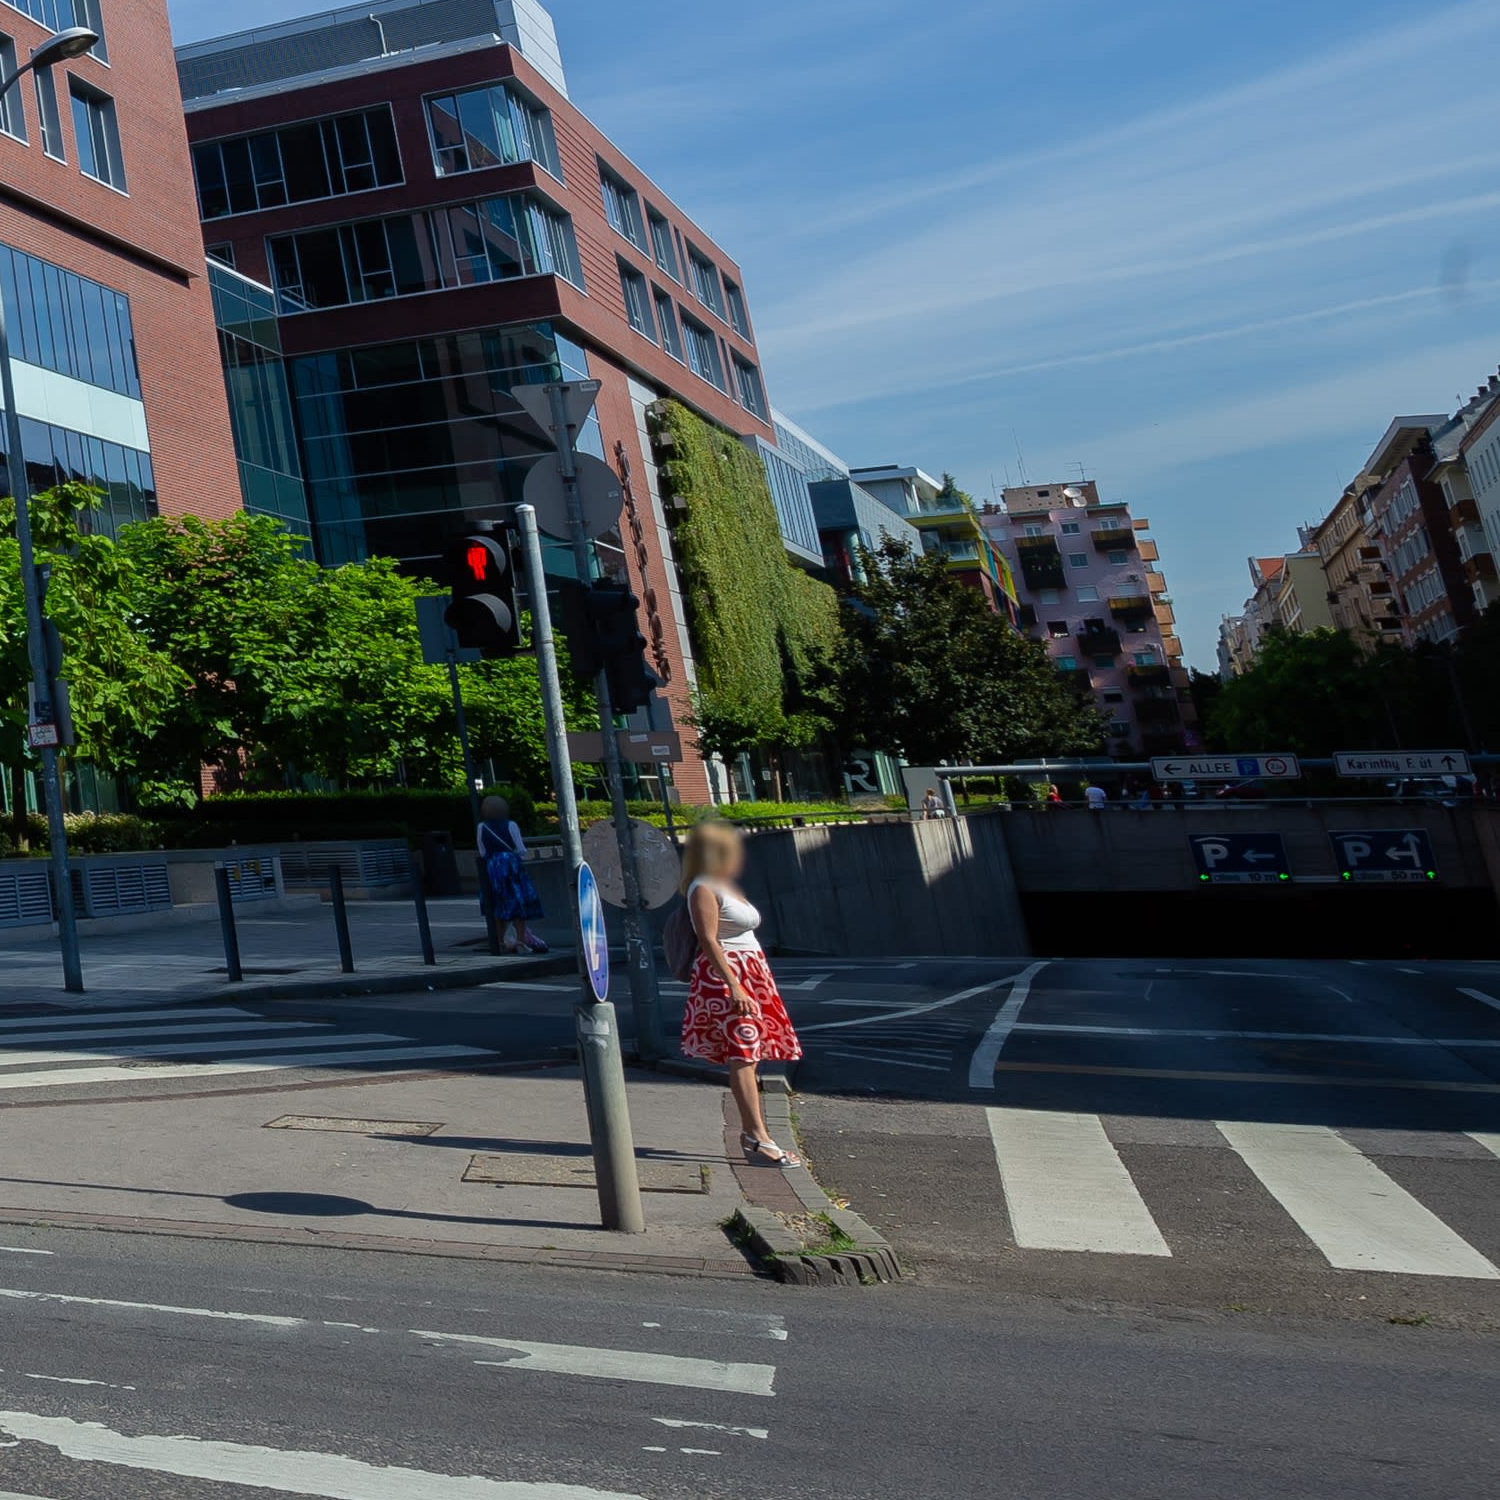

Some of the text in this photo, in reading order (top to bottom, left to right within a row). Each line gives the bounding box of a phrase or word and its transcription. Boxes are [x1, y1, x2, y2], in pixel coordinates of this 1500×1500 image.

[1188, 762, 1232, 775] ALLEE
[1347, 758, 1399, 771] Karinthy
[1420, 756, 1432, 769] út
[1201, 843, 1229, 869] P
[1344, 841, 1371, 866] P
[1391, 870, 1407, 880] 50
